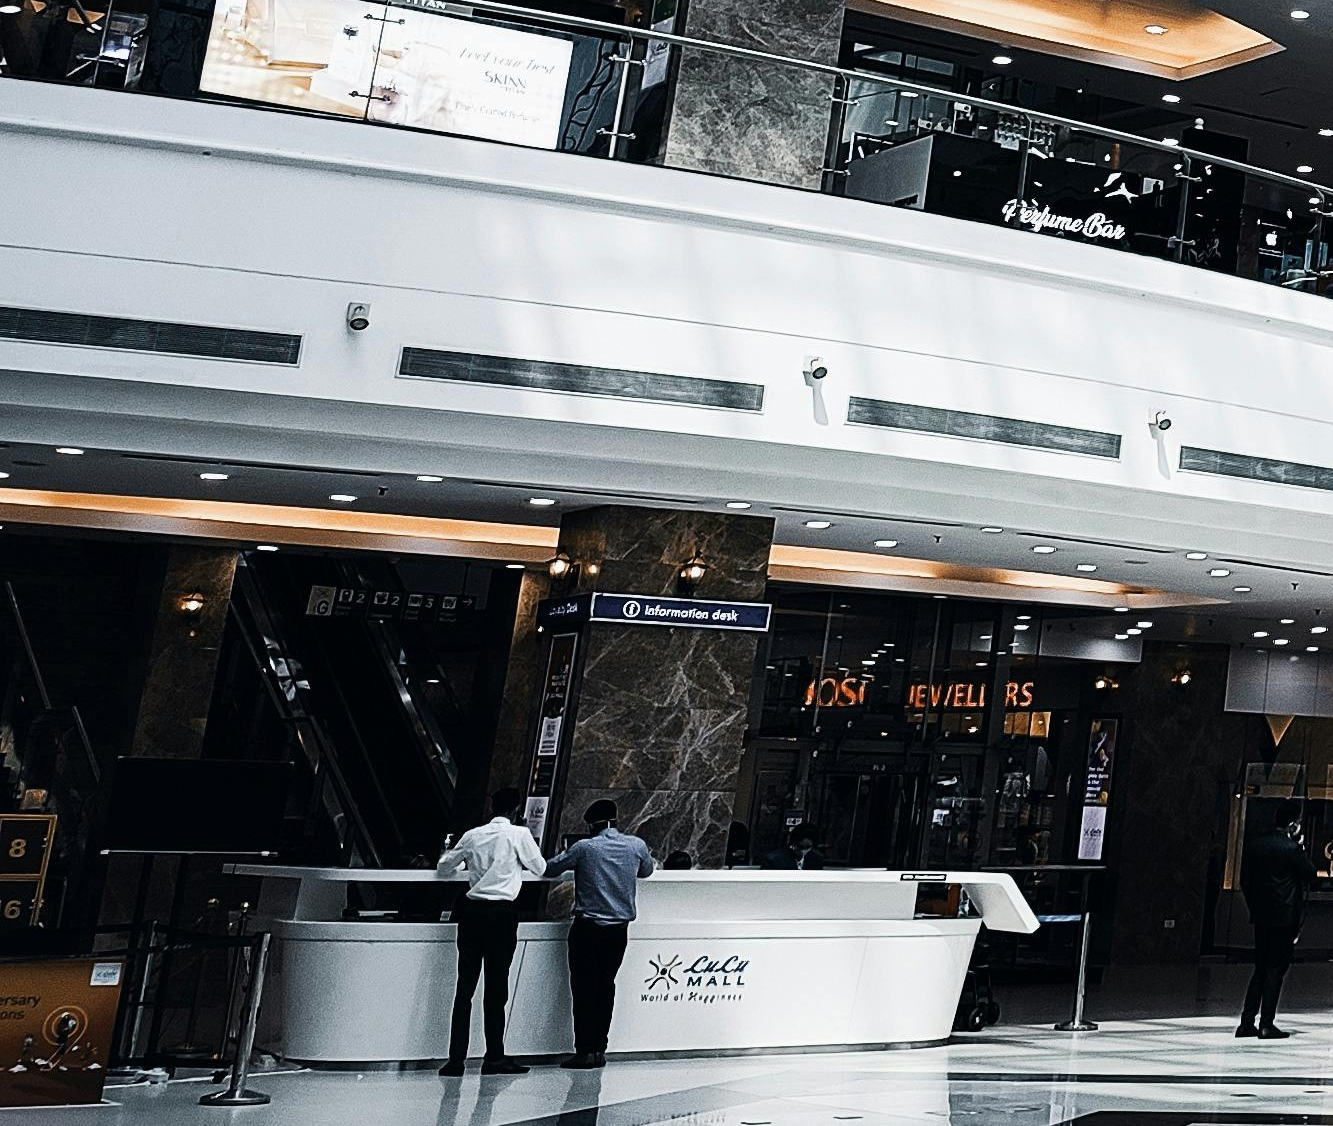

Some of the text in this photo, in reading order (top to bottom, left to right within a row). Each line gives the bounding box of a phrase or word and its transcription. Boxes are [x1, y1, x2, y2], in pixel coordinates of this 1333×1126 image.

[1002, 199, 1126, 240] Perfume Bar
[356, 593, 366, 604] 2
[391, 595, 400, 606] 2
[645, 604, 739, 622] Information desk
[8, 838, 27, 858] 8
[683, 955, 751, 974] LuLu
[686, 975, 746, 987] MALL
[640, 993, 669, 1002] World
[673, 993, 684, 1002] of
